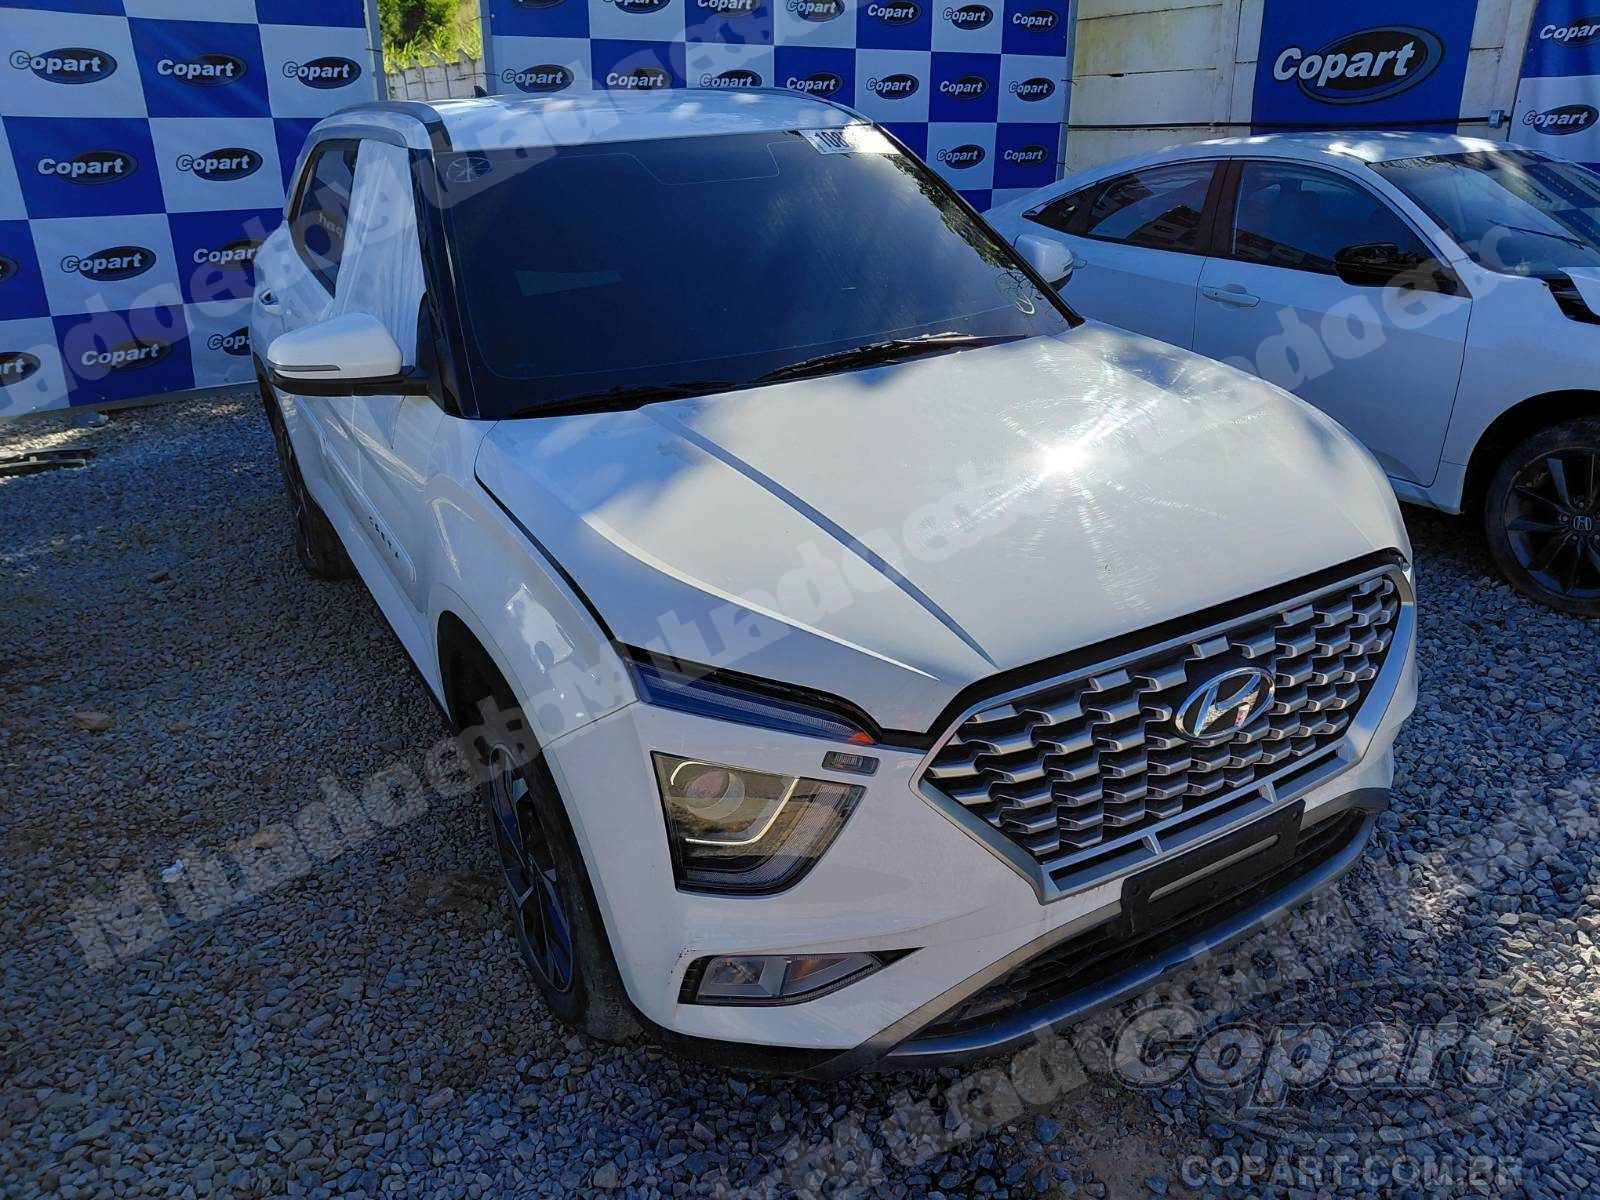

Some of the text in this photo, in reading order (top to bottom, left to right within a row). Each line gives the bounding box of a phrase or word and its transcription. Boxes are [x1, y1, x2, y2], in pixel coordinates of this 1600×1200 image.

[787, 0, 836, 13] Copart
[867, 4, 915, 20] Copart
[943, 8, 986, 22] Copart
[1012, 13, 1053, 27] Copart
[1540, 24, 1600, 42] Copar
[9, 51, 101, 74] Copart
[157, 58, 234, 79] Copart
[283, 61, 350, 79] Copart
[1273, 41, 1415, 87] Copart
[502, 70, 564, 85] Copart
[606, 72, 663, 87] Copart
[701, 75, 752, 87] Copart
[786, 77, 836, 93] Copart
[866, 78, 912, 92] Copart
[940, 81, 983, 95] Copart
[1009, 82, 1048, 96] Copart
[1523, 111, 1588, 128] Copart
[937, 149, 978, 162] Copart
[1004, 149, 1043, 162] Copart
[38, 155, 124, 177] Copart
[176, 154, 250, 175] Copart
[61, 254, 143, 273] Copart
[81, 343, 160, 366] Copart
